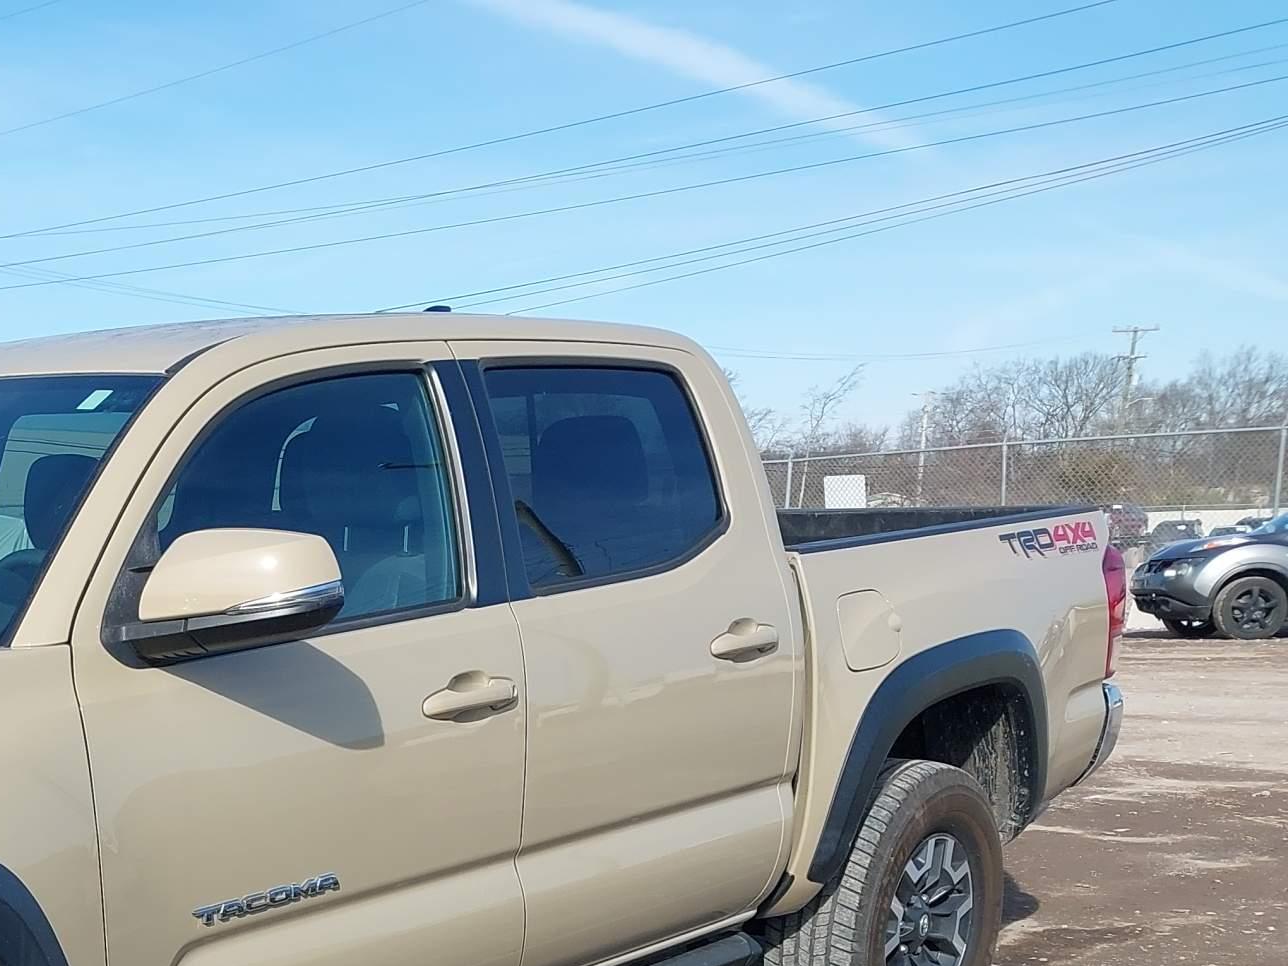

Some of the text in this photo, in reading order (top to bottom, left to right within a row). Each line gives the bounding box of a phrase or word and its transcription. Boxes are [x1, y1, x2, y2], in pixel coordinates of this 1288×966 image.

[999, 528, 1054, 558] TRD
[1058, 542, 1098, 554] OFF ROAD
[192, 871, 342, 927] TACOMA
